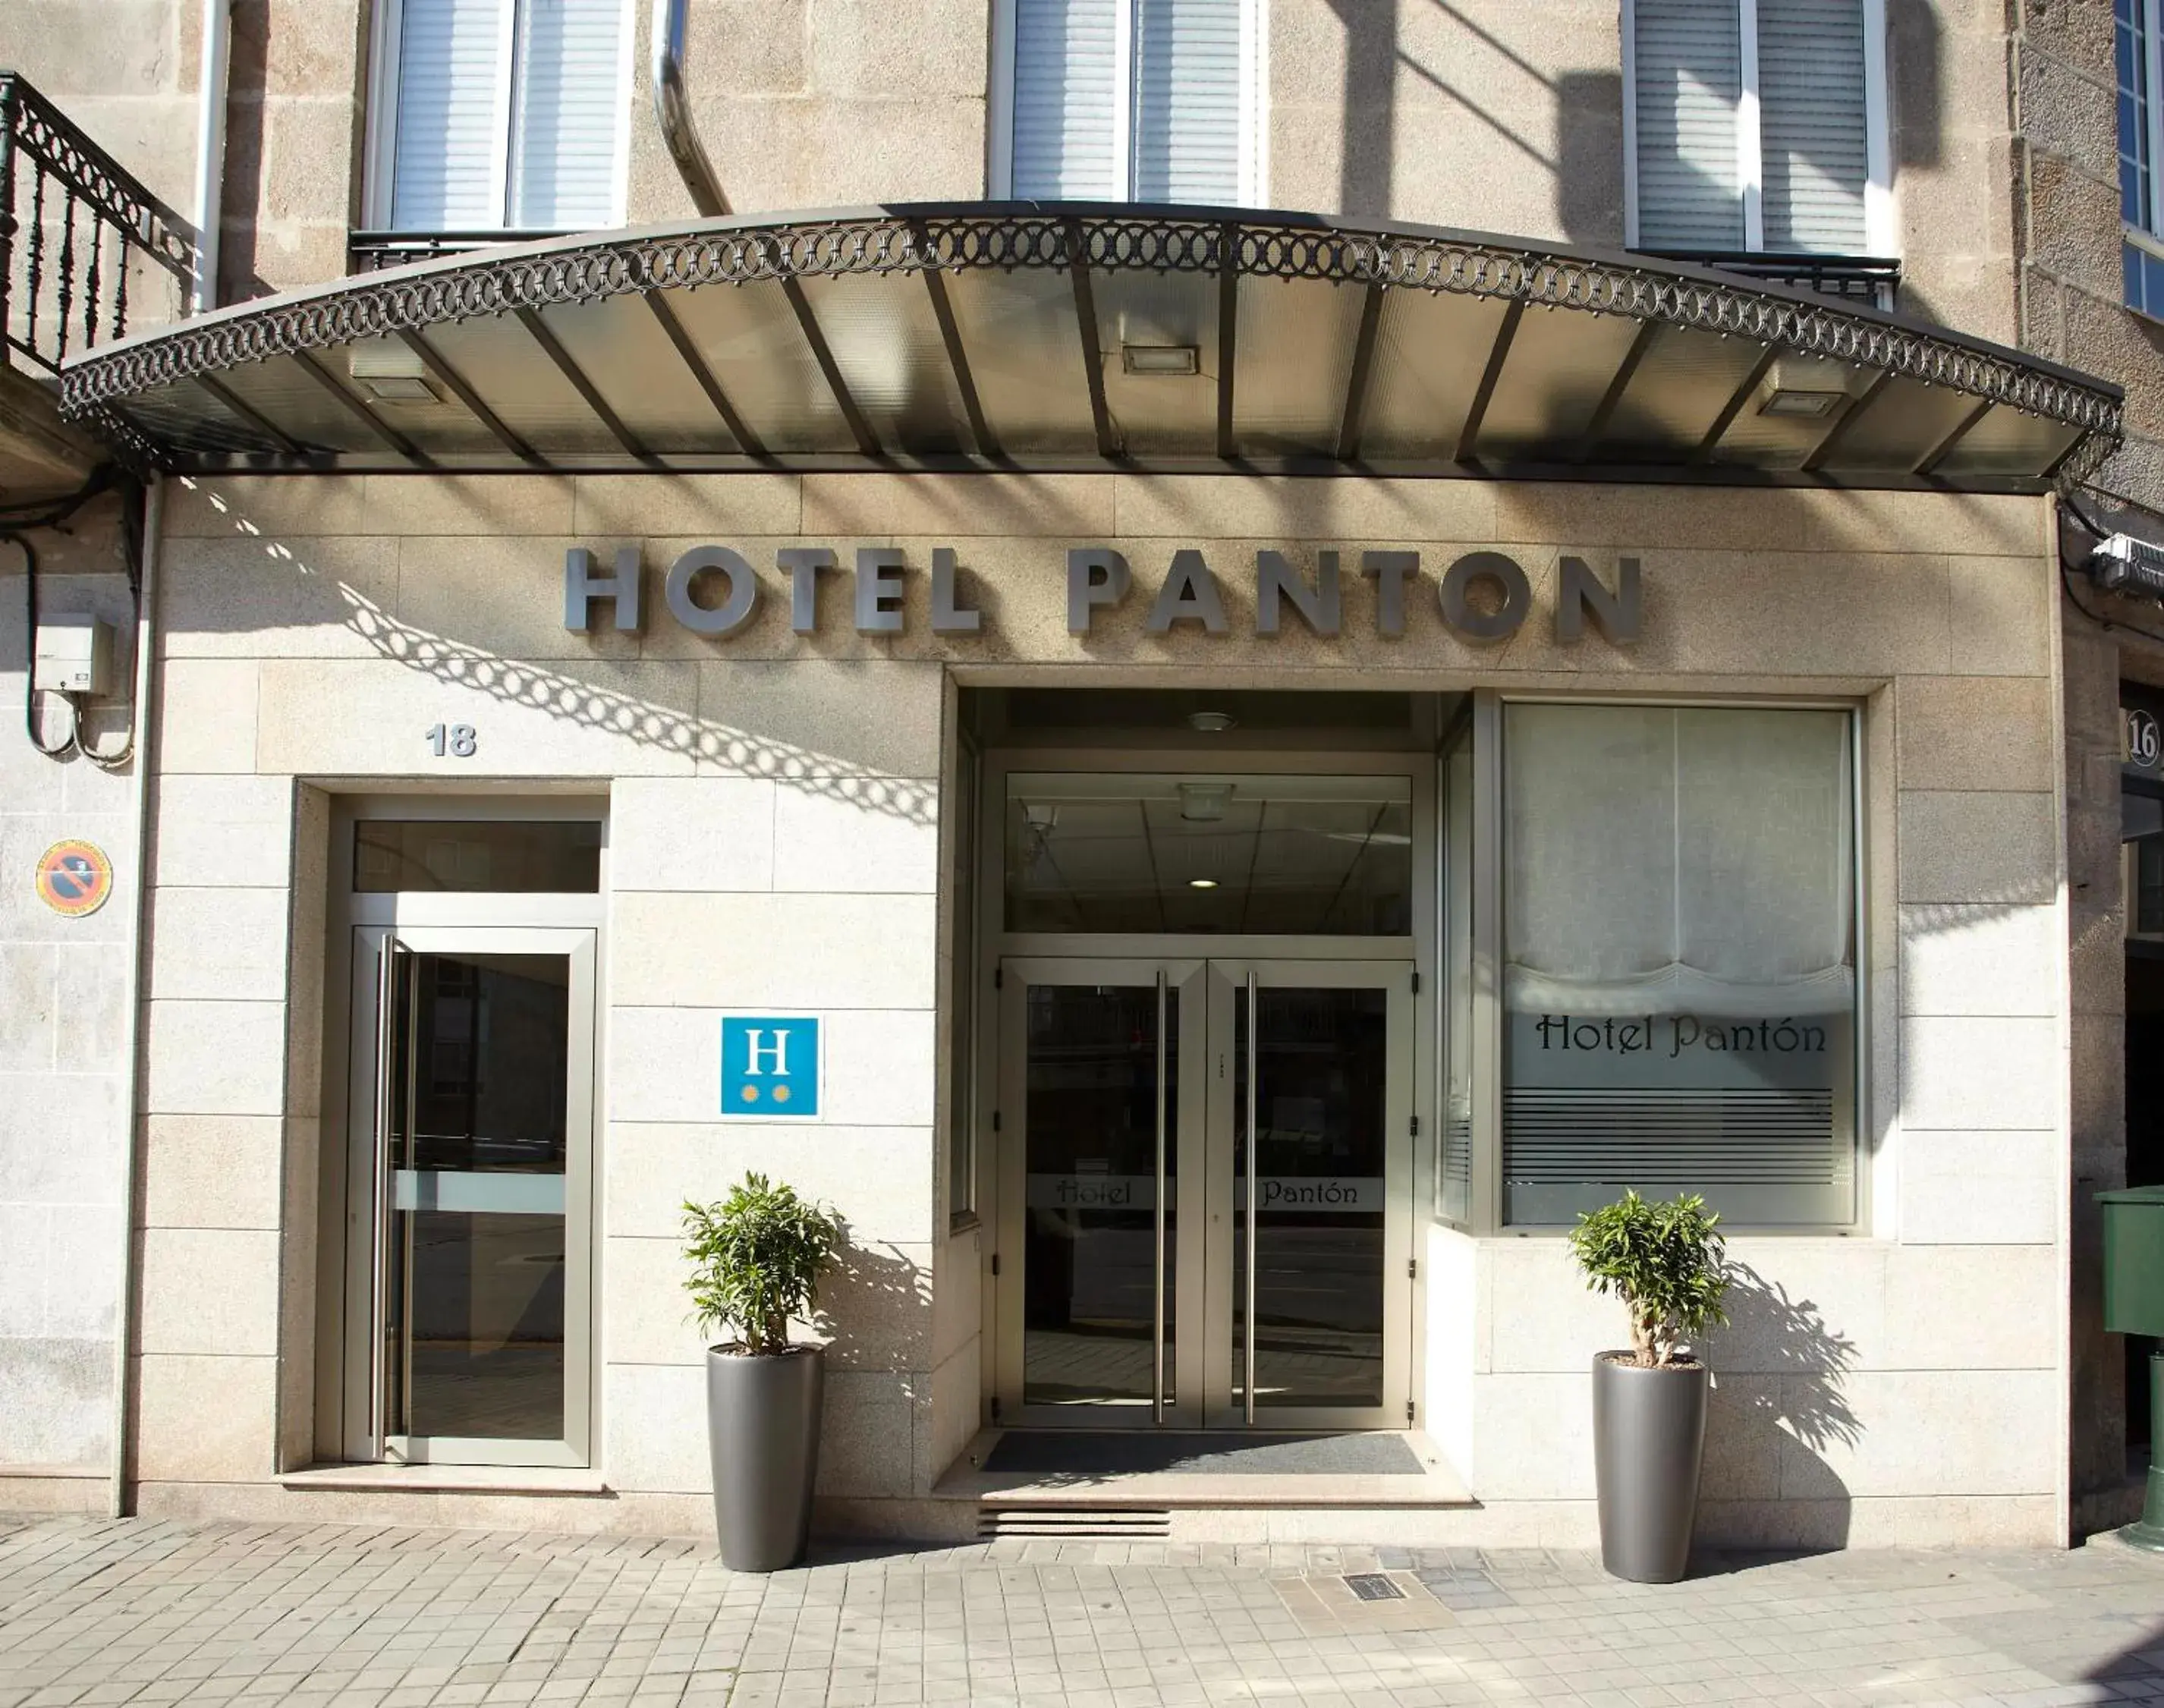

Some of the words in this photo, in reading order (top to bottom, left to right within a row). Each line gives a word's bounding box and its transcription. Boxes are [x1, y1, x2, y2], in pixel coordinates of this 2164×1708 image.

[565, 546, 980, 636] HOTEL
[1066, 549, 1641, 646] PANTON
[425, 723, 477, 757] 18
[2130, 719, 2156, 757] 16
[744, 1029, 791, 1076] H
[1536, 1014, 1653, 1054] Hotel
[1669, 1014, 1826, 1058] Pantón
[1056, 1180, 1131, 1207] Hotel
[1262, 1181, 1358, 1206] Pantón
